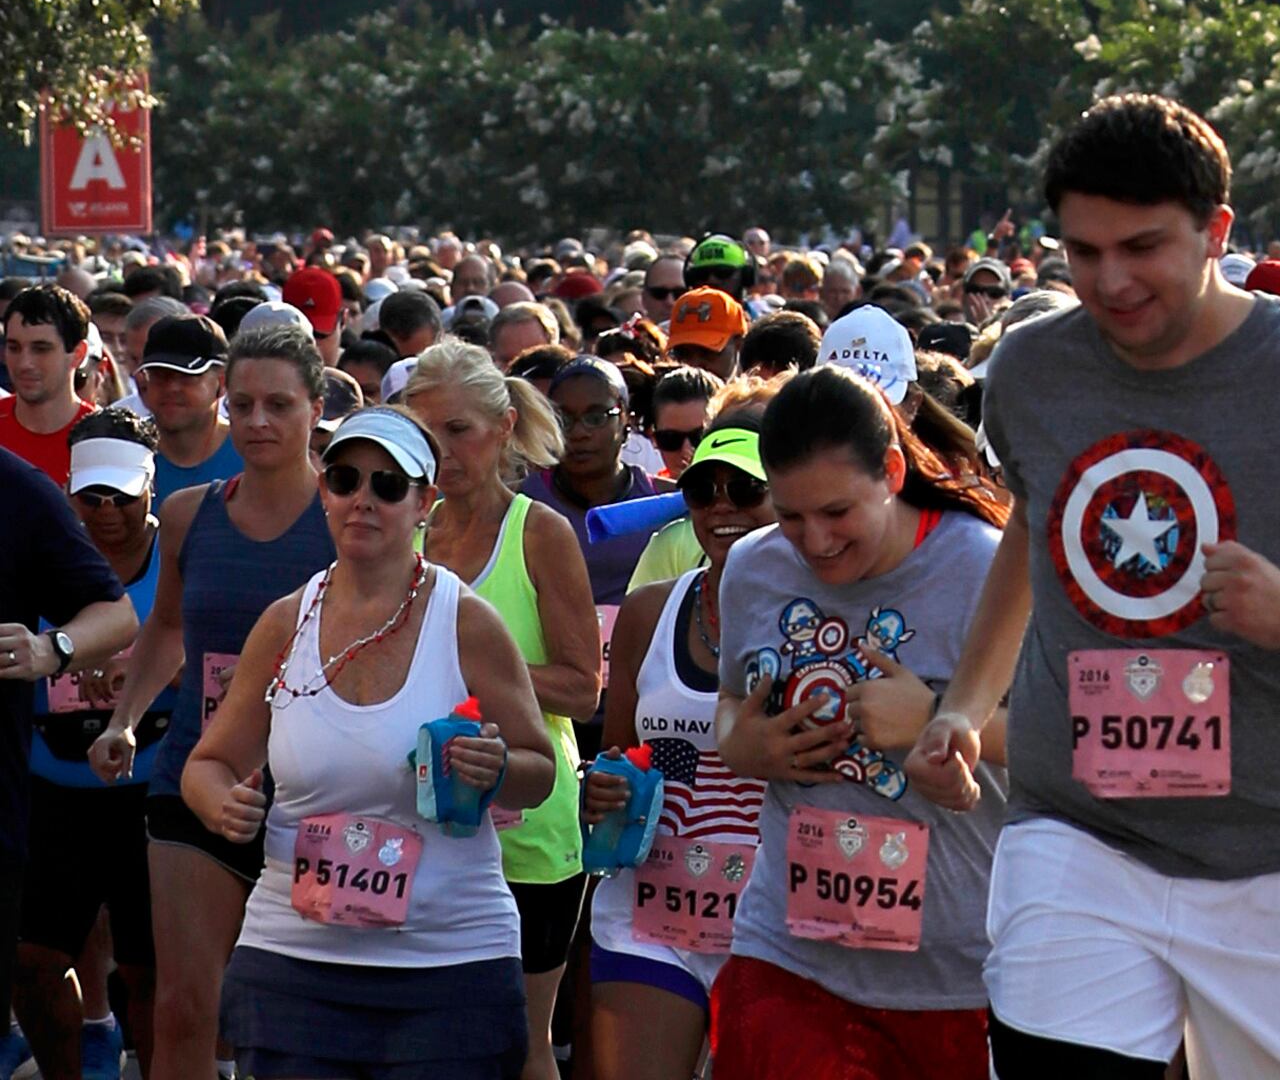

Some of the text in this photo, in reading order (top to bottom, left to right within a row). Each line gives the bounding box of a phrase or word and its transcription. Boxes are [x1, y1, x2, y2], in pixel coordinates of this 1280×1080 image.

[69, 123, 127, 191] A
[842, 350, 889, 362] DELTA
[1079, 670, 1110, 682] 2016
[642, 717, 715, 735] OLD NAV
[1072, 715, 1222, 750] P 50741
[306, 823, 332, 835] 2016
[798, 823, 824, 837] 2016
[294, 858, 408, 899] P 51401
[790, 862, 921, 911] P 50954
[637, 882, 657, 908] P
